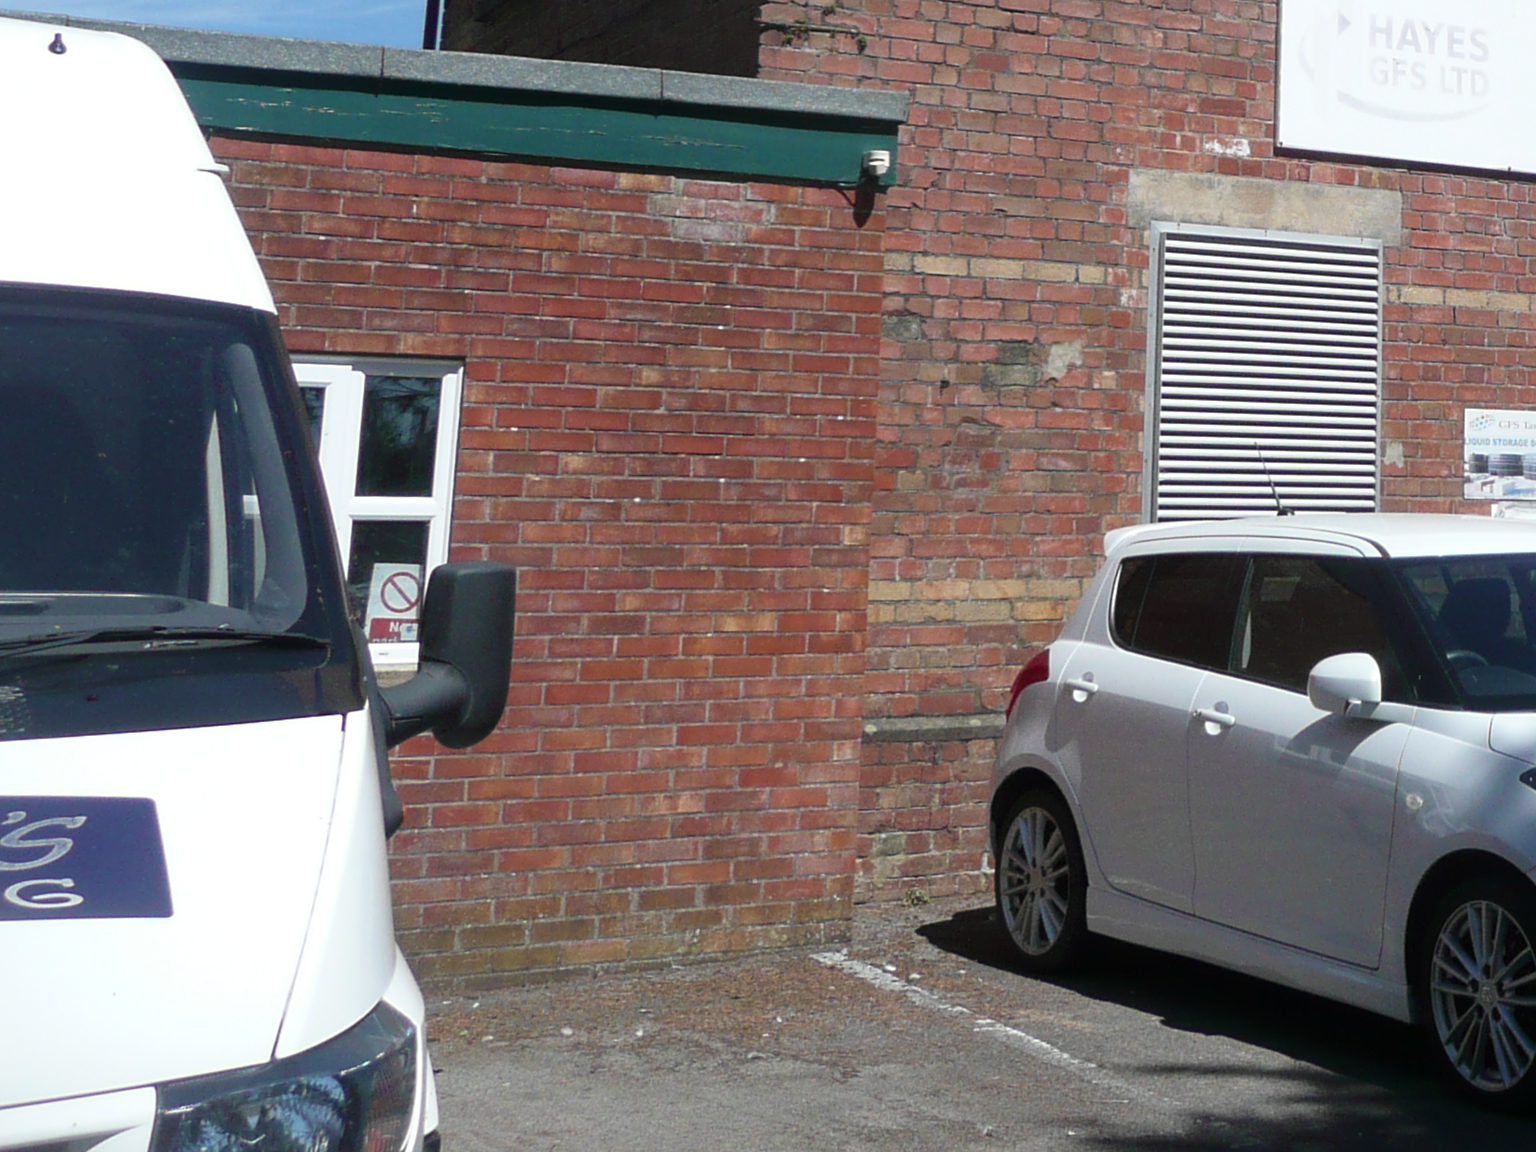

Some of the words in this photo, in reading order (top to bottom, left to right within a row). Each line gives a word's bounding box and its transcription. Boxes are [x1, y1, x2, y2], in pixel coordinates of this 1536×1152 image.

[1368, 13, 1490, 62] HAYES
[1368, 55, 1427, 91] GFS
[1439, 64, 1489, 97] LTD
[1498, 420, 1520, 430] GFS
[1464, 437, 1491, 446] LIQUID
[1493, 438, 1529, 447] STORAGE
